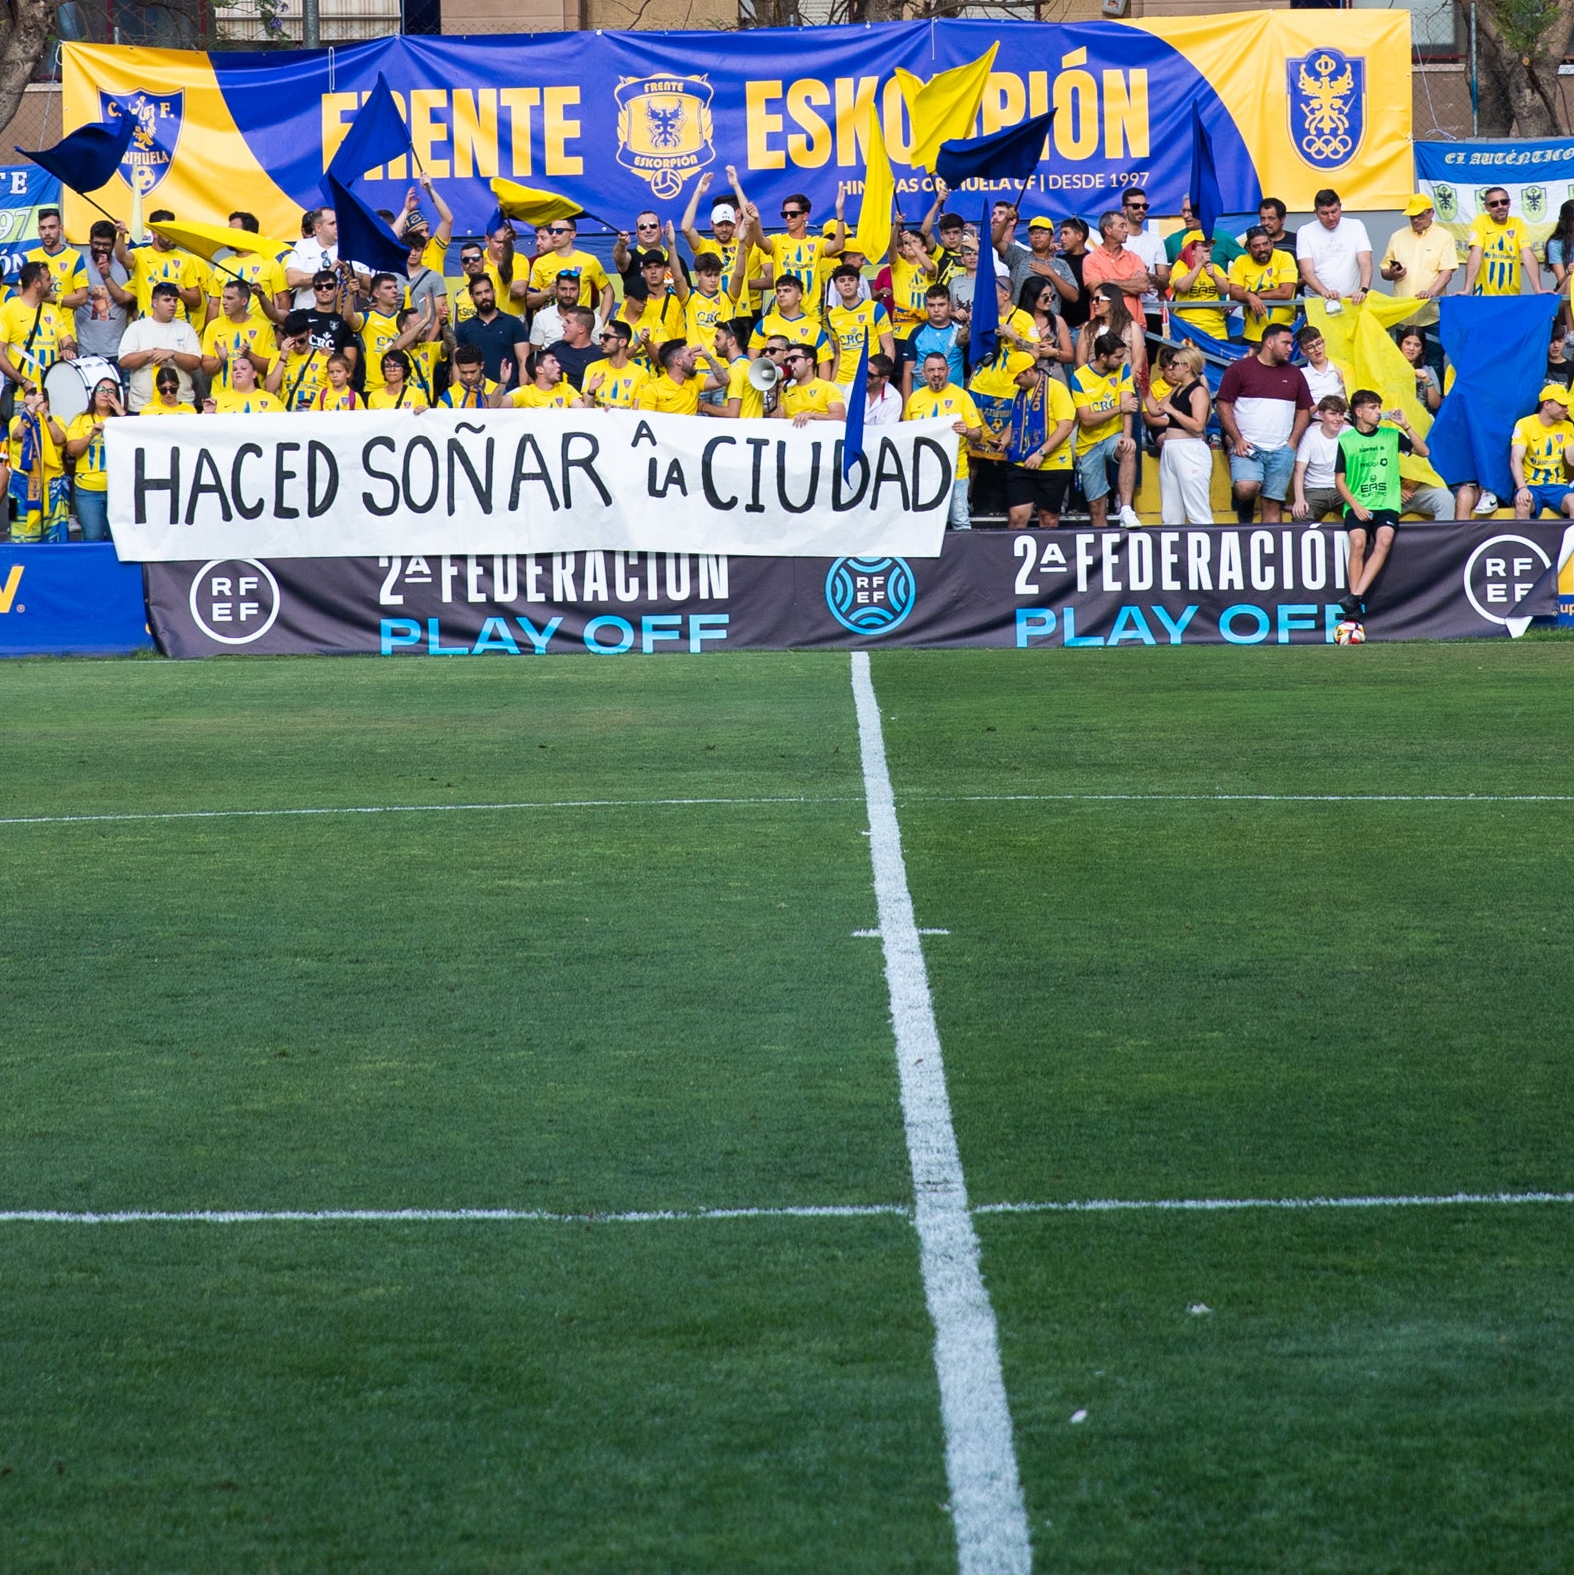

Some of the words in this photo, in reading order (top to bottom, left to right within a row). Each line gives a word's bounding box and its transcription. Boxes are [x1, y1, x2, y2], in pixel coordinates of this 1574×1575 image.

[644, 81, 683, 93] FRENTE
[745, 45, 1150, 170] ESKOPIÓN
[121, 150, 169, 166] RIHUELA
[634, 155, 698, 168] ESKORPIÓN
[838, 177, 921, 195] HINAS
[1049, 174, 1106, 190] DESDE
[1110, 172, 1150, 189] 1997
[308, 334, 336, 350] CRC
[839, 333, 864, 345] CRC
[134, 440, 339, 525] HACED
[362, 421, 613, 517] SOÑAR
[630, 420, 657, 447] A
[647, 457, 688, 497] LA
[702, 435, 952, 513] CIUDAD
[1360, 483, 1387, 493] EAS
[1015, 604, 1199, 647] PLAY
[381, 616, 563, 655] PLAY
[583, 613, 730, 654] OFF
